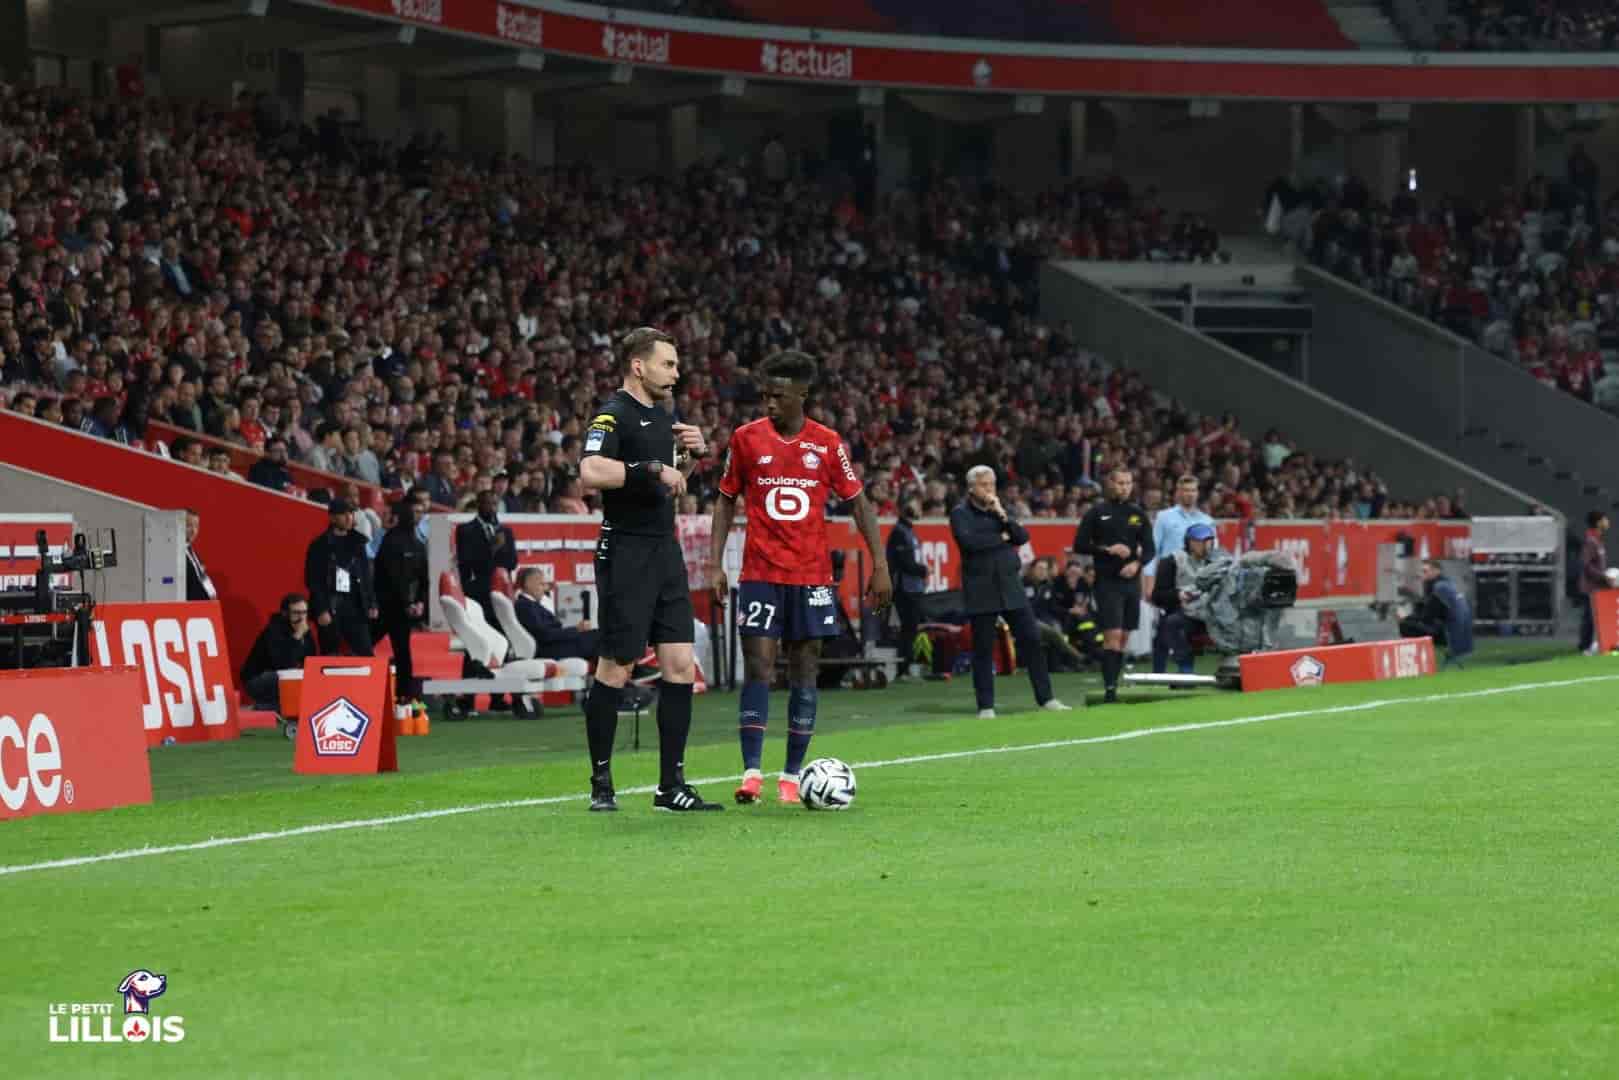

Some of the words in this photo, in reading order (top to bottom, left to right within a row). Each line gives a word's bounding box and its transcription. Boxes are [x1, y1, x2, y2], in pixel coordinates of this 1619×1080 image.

[614, 28, 669, 63] actual
[780, 44, 853, 79] actual
[757, 476, 820, 489] boulanger
[746, 601, 776, 631] 27
[322, 740, 353, 751] LOSC
